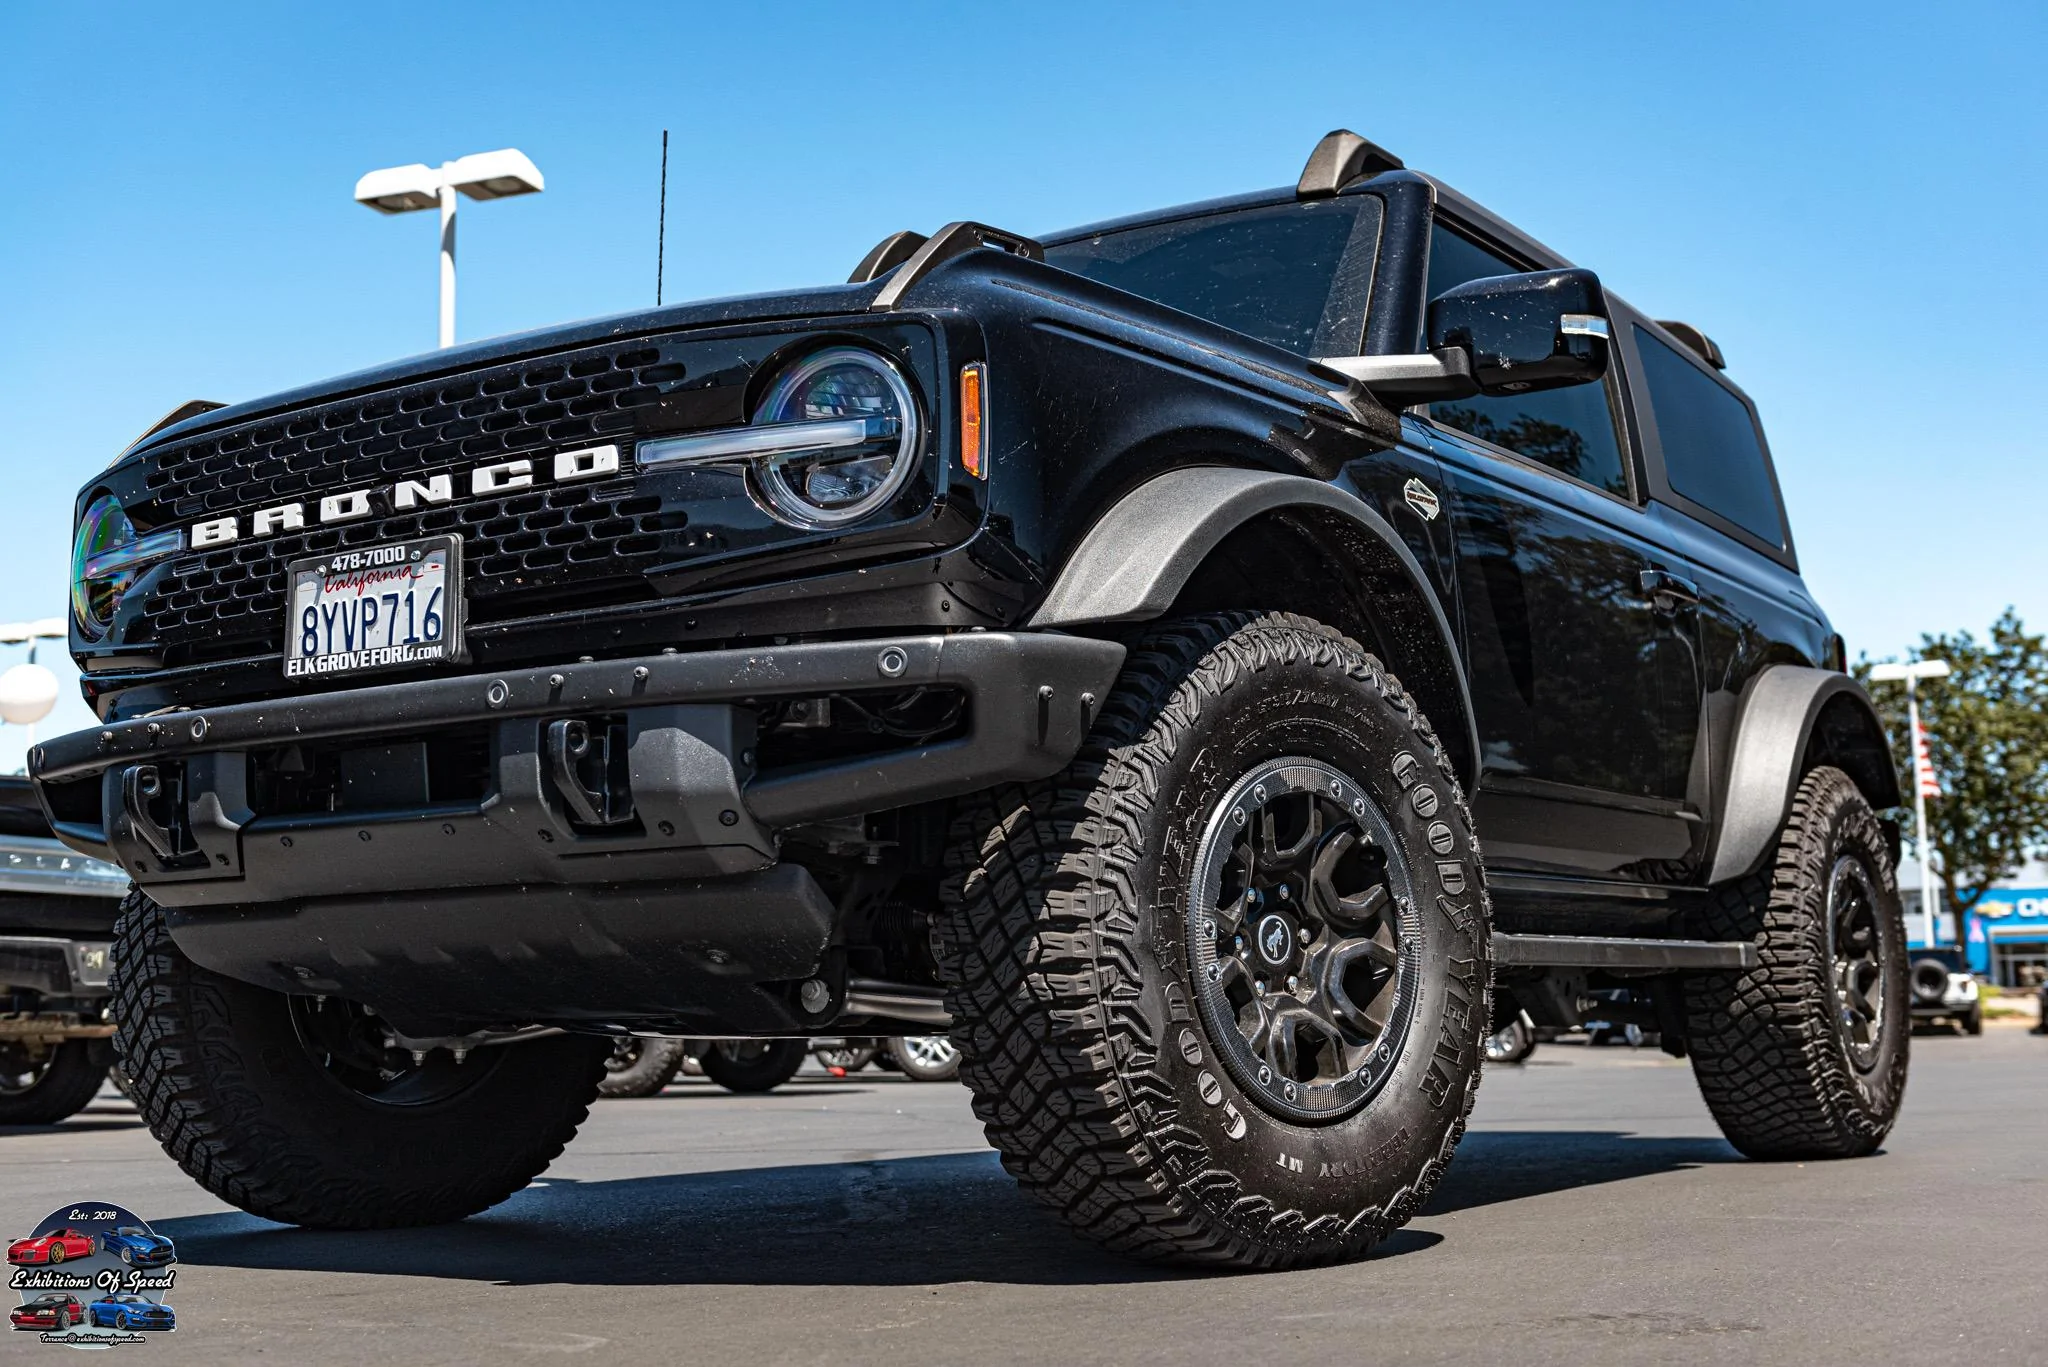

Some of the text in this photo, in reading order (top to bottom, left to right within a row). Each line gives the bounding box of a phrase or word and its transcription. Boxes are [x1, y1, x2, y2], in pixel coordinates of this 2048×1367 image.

[191, 444, 619, 550] BRONCO
[331, 546, 406, 572] 478-7000
[324, 564, 424, 597] California
[302, 586, 442, 657] 8YVP716
[1276, 1152, 1304, 1174] MT
